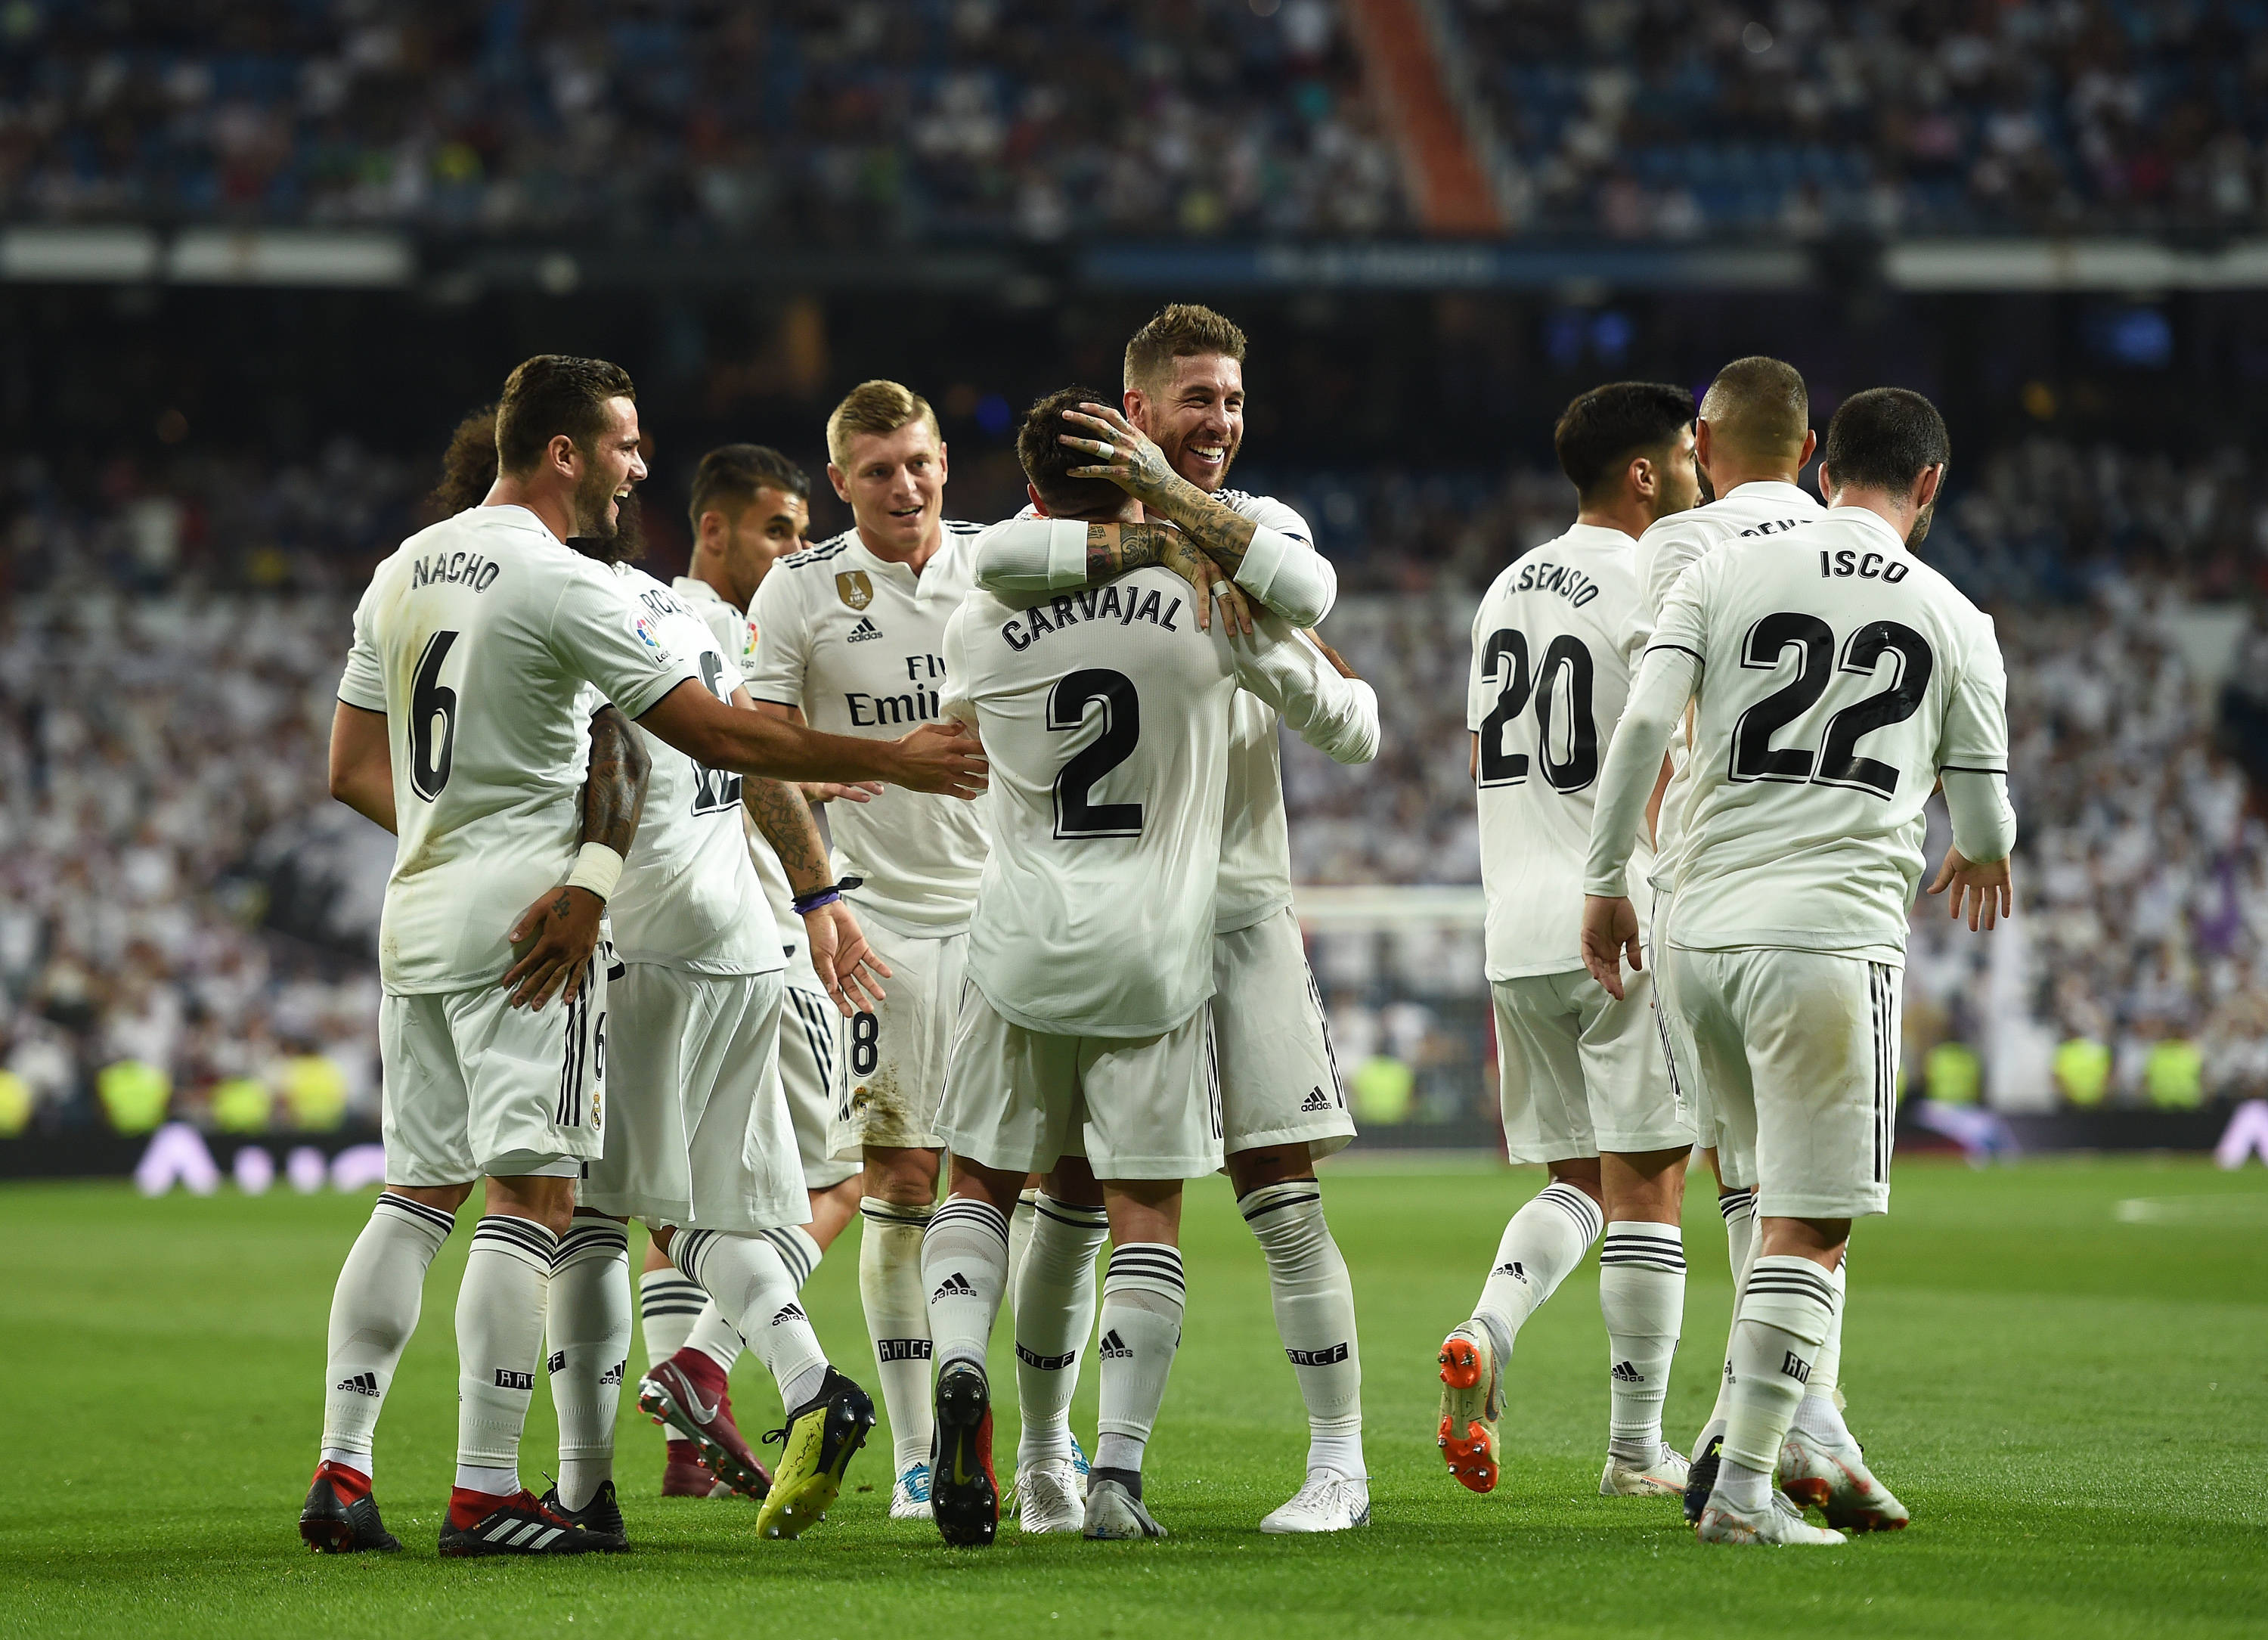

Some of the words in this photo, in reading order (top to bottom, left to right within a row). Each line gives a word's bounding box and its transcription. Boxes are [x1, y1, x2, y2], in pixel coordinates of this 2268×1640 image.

[411, 552, 500, 594] NACHO
[1502, 563, 1599, 609] ASENSIO
[1820, 550, 1909, 584] ISCO
[847, 631, 883, 643] adidas
[1002, 585, 1182, 652] CARVAJAL
[407, 631, 459, 804] 6
[1479, 629, 1598, 795] 20
[1727, 612, 1933, 801] 22
[1046, 668, 1142, 840] 2
[850, 1011, 878, 1077] 8
[1301, 1101, 1332, 1112] adidas
[931, 1287, 978, 1305] adidas
[879, 1341, 931, 1361] RMCF
[1287, 1345, 1344, 1365] RMCF
[337, 1383, 380, 1398] adidas
